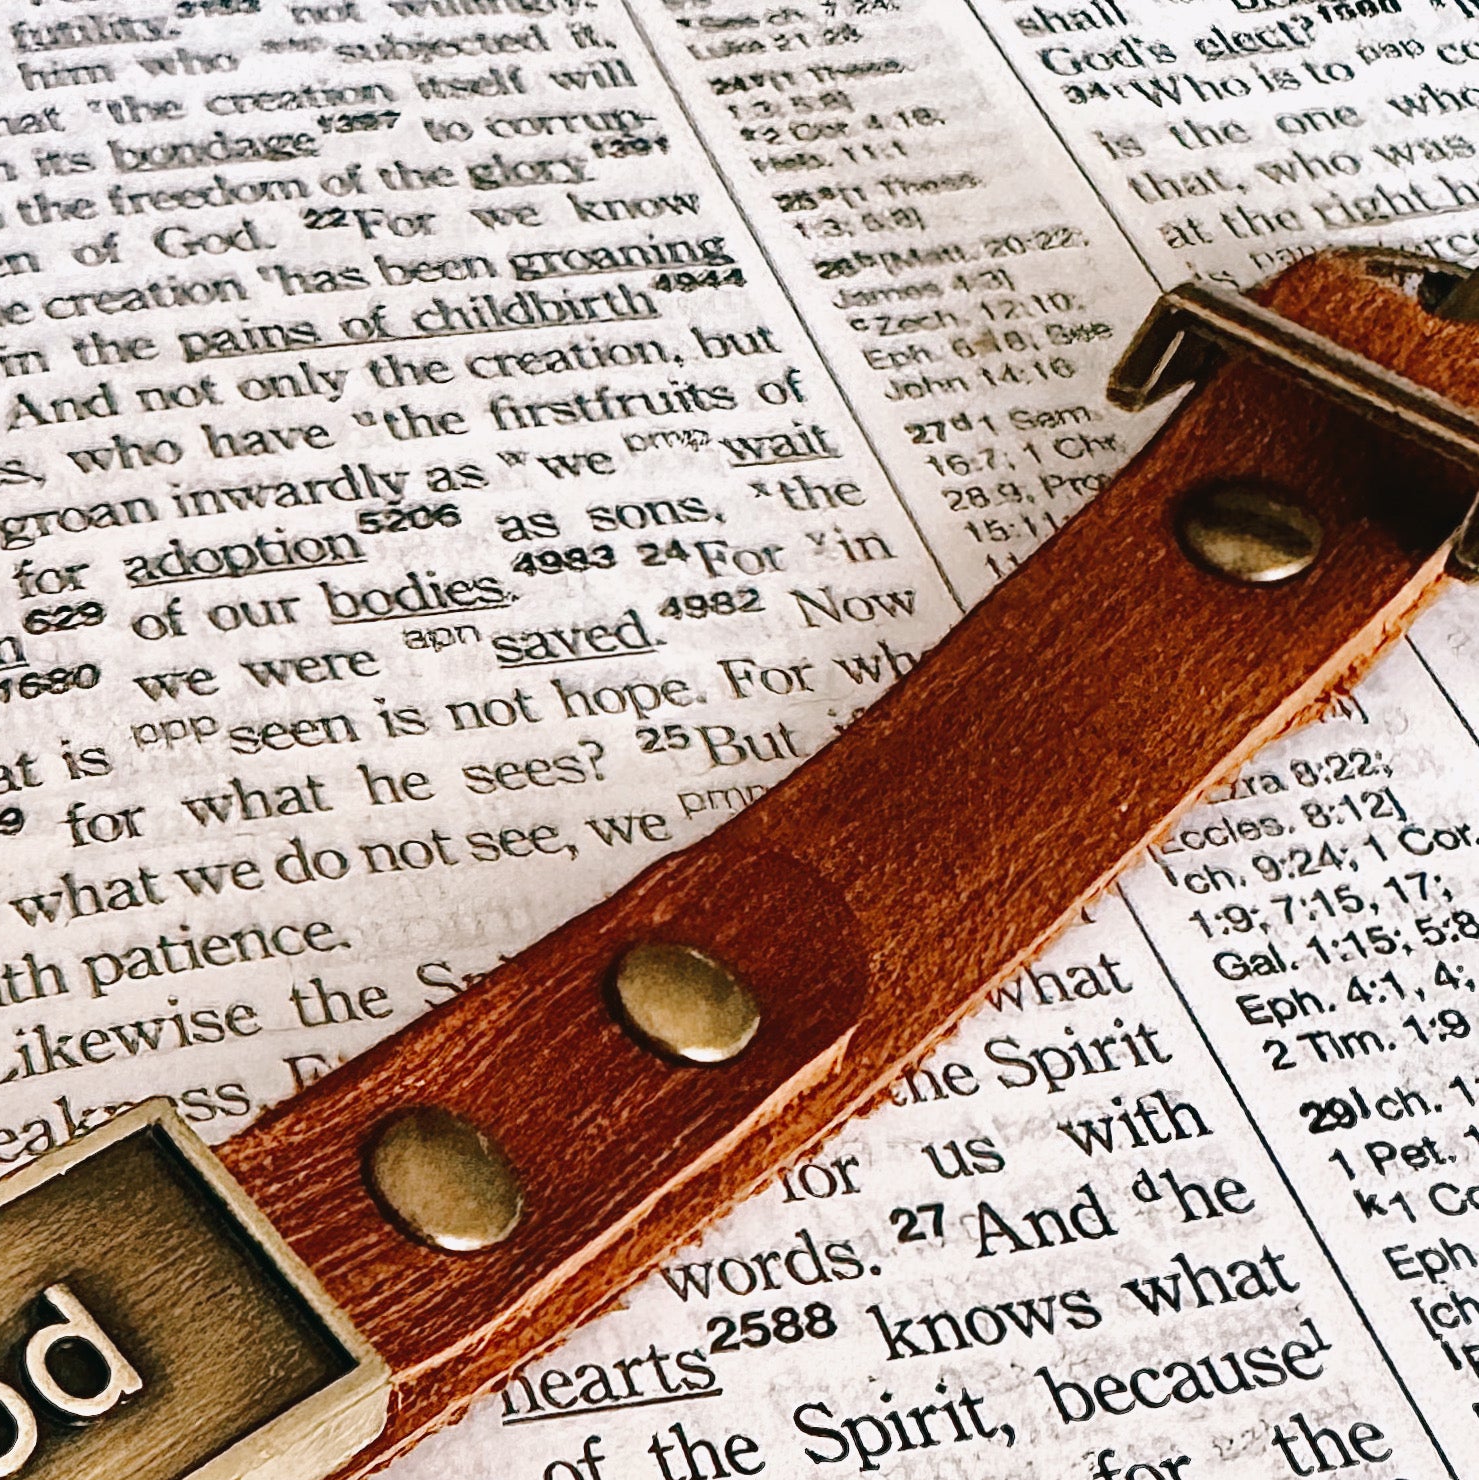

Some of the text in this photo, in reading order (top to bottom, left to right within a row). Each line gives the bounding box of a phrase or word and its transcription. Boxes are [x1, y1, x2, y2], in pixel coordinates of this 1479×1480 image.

[1169, 101, 1367, 151] the one
[1254, 148, 1361, 185] who
[1162, 203, 1303, 251] at the
[136, 322, 783, 413] not only the but
[203, 421, 336, 460] have
[757, 367, 807, 406] of
[172, 424, 841, 517] inwardly as wait
[497, 512, 560, 542] as
[788, 584, 916, 629] Now
[133, 661, 219, 701] we
[240, 645, 380, 688] were
[60, 740, 114, 781] is
[378, 697, 430, 740] is
[450, 688, 544, 730] not
[718, 657, 817, 699] For
[63, 740, 606, 847] for what he sees?
[10, 868, 170, 928] what
[176, 858, 265, 898] we
[275, 838, 350, 890] do
[363, 828, 471, 876] not
[467, 822, 578, 862] see,
[586, 809, 673, 846] we
[1384, 872, 1455, 902] 17;
[82, 919, 351, 998] patience.
[1212, 944, 1299, 981] Gal.
[290, 977, 392, 1024] the
[1236, 988, 1335, 1029] Eph.
[984, 1018, 1173, 1094] Spirit
[1296, 1009, 1472, 1061] Tim. 1:9
[922, 1090, 1214, 1179] us with
[1365, 1138, 1456, 1175] Pet.
[657, 1229, 883, 1303] words.
[867, 1247, 1301, 1361] knows what
[793, 1378, 1017, 1472] Spirit,
[1271, 1412, 1393, 1479] the
